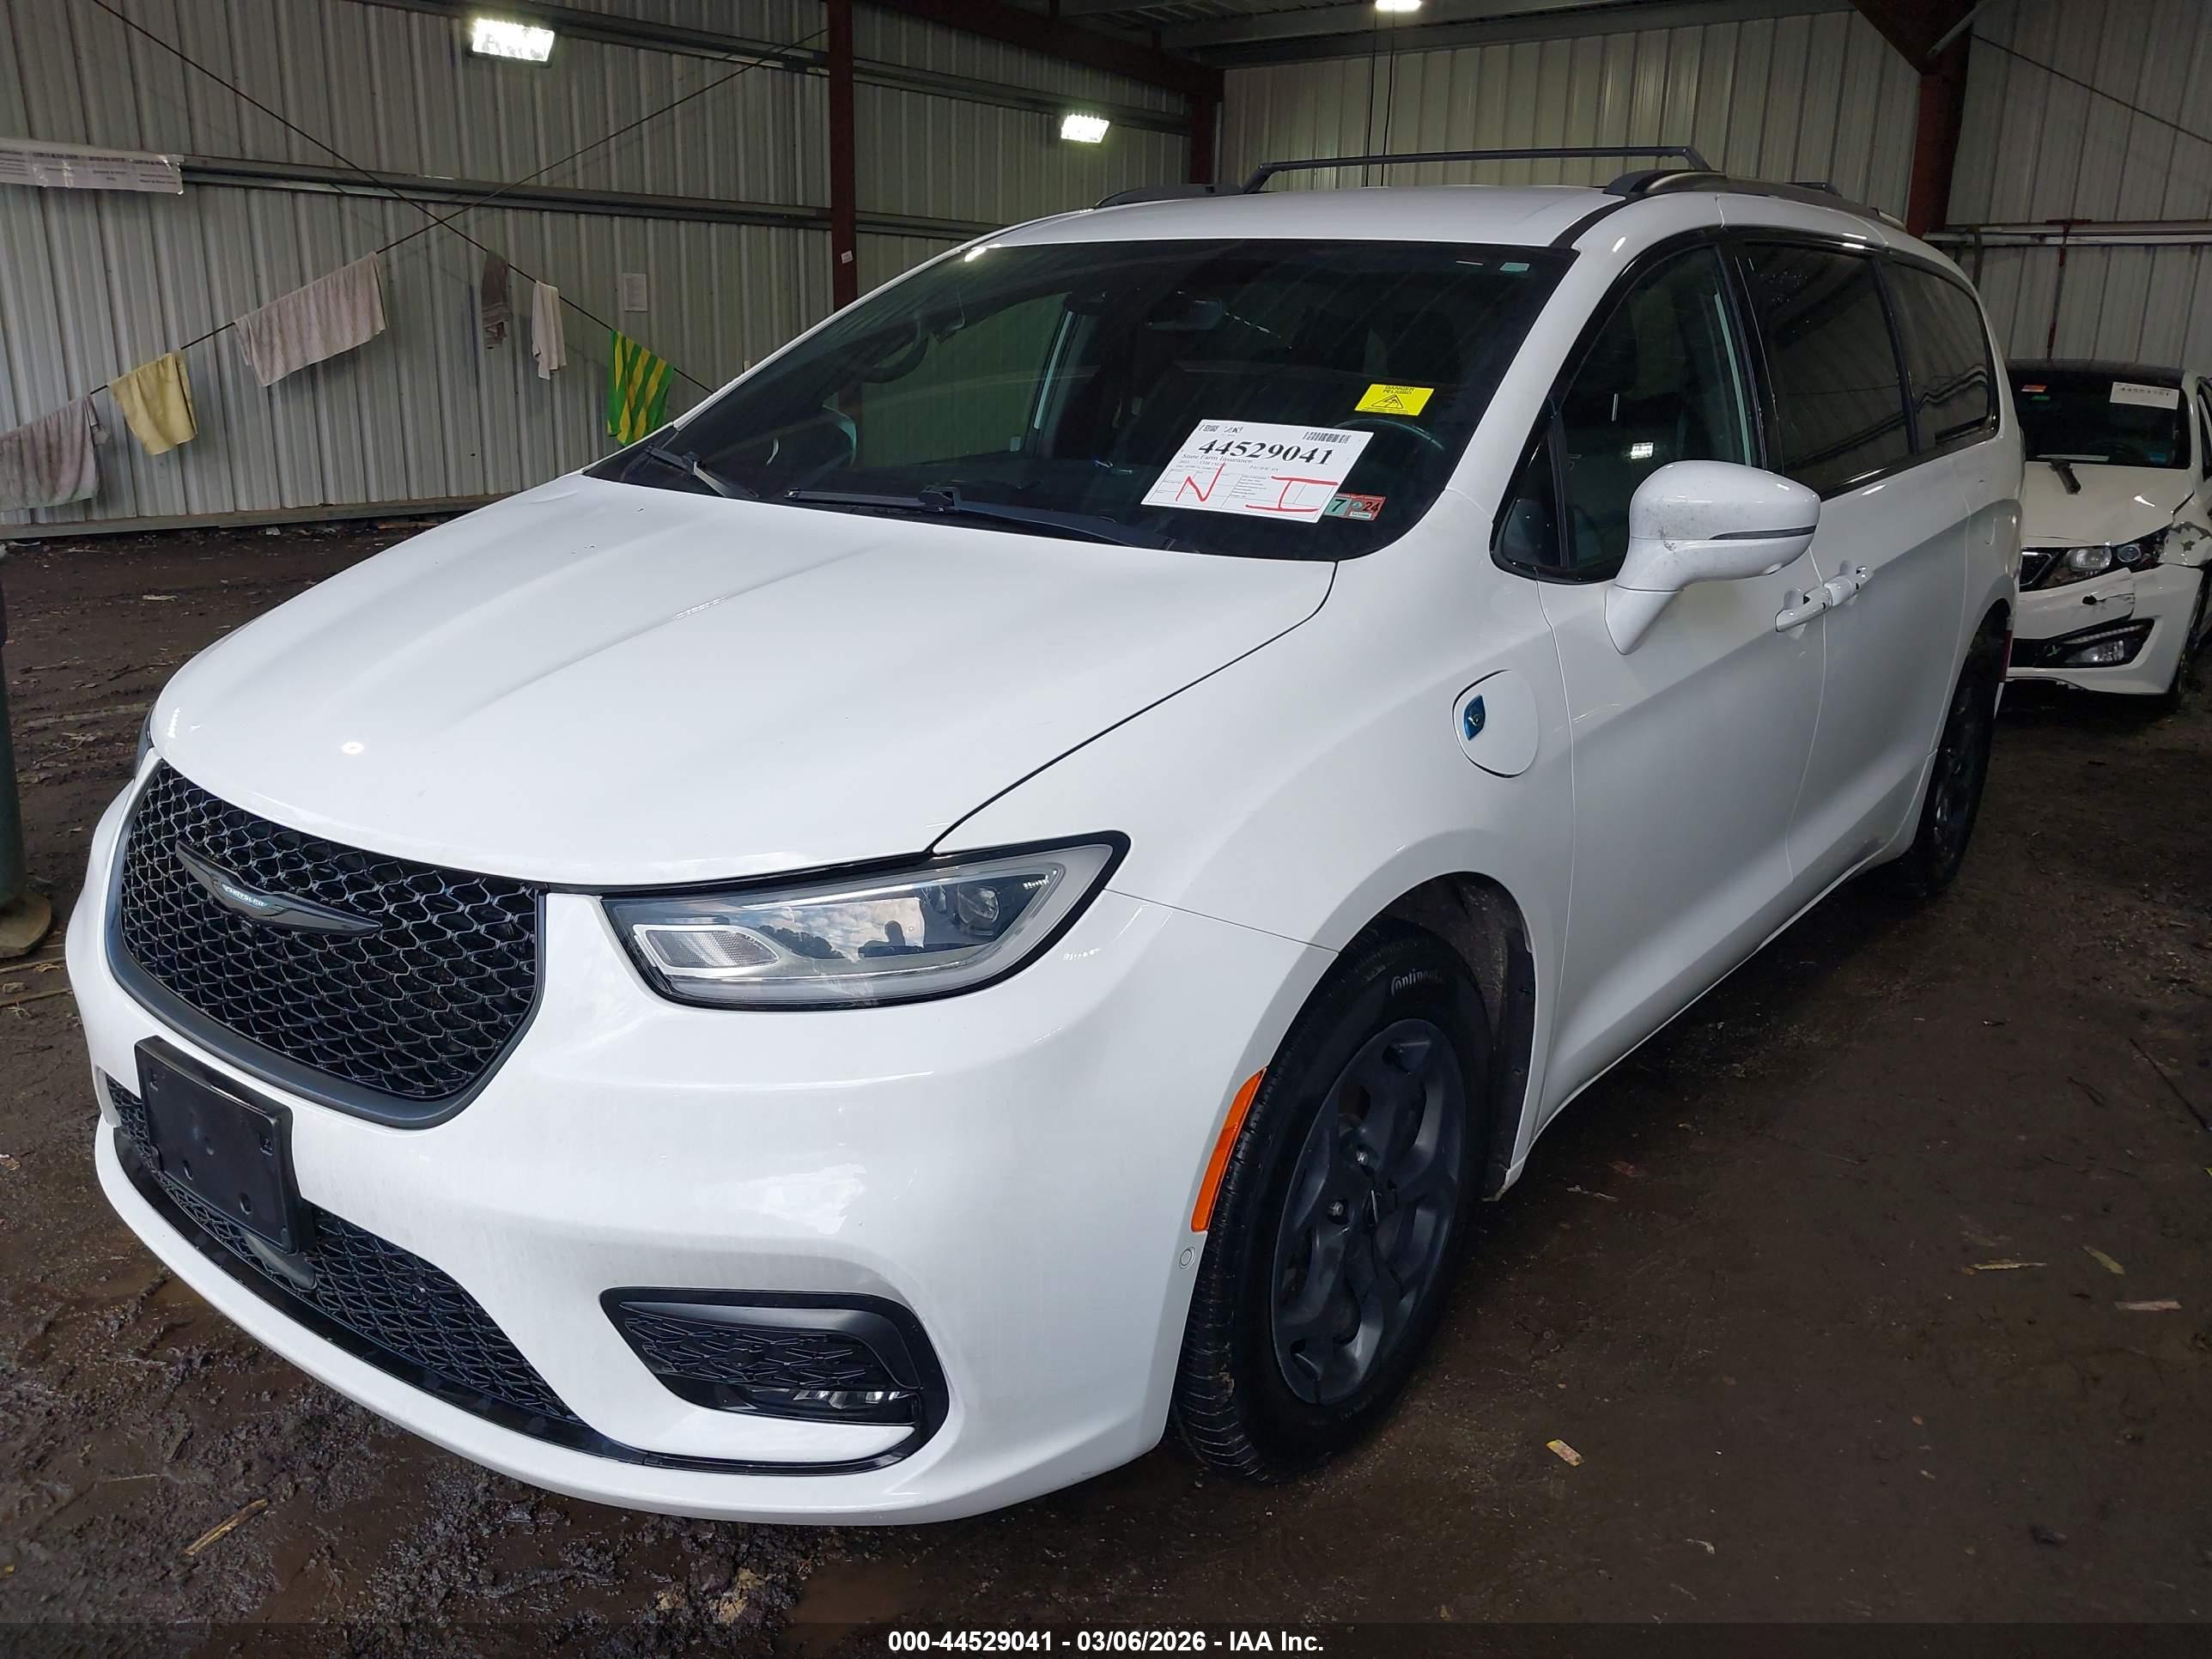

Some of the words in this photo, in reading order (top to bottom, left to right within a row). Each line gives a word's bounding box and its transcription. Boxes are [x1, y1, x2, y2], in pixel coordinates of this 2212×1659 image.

[1198, 439, 1334, 465] 44529041
[1176, 461, 1225, 502] N
[1331, 499, 1347, 513] 7
[1362, 501, 1381, 513] 24
